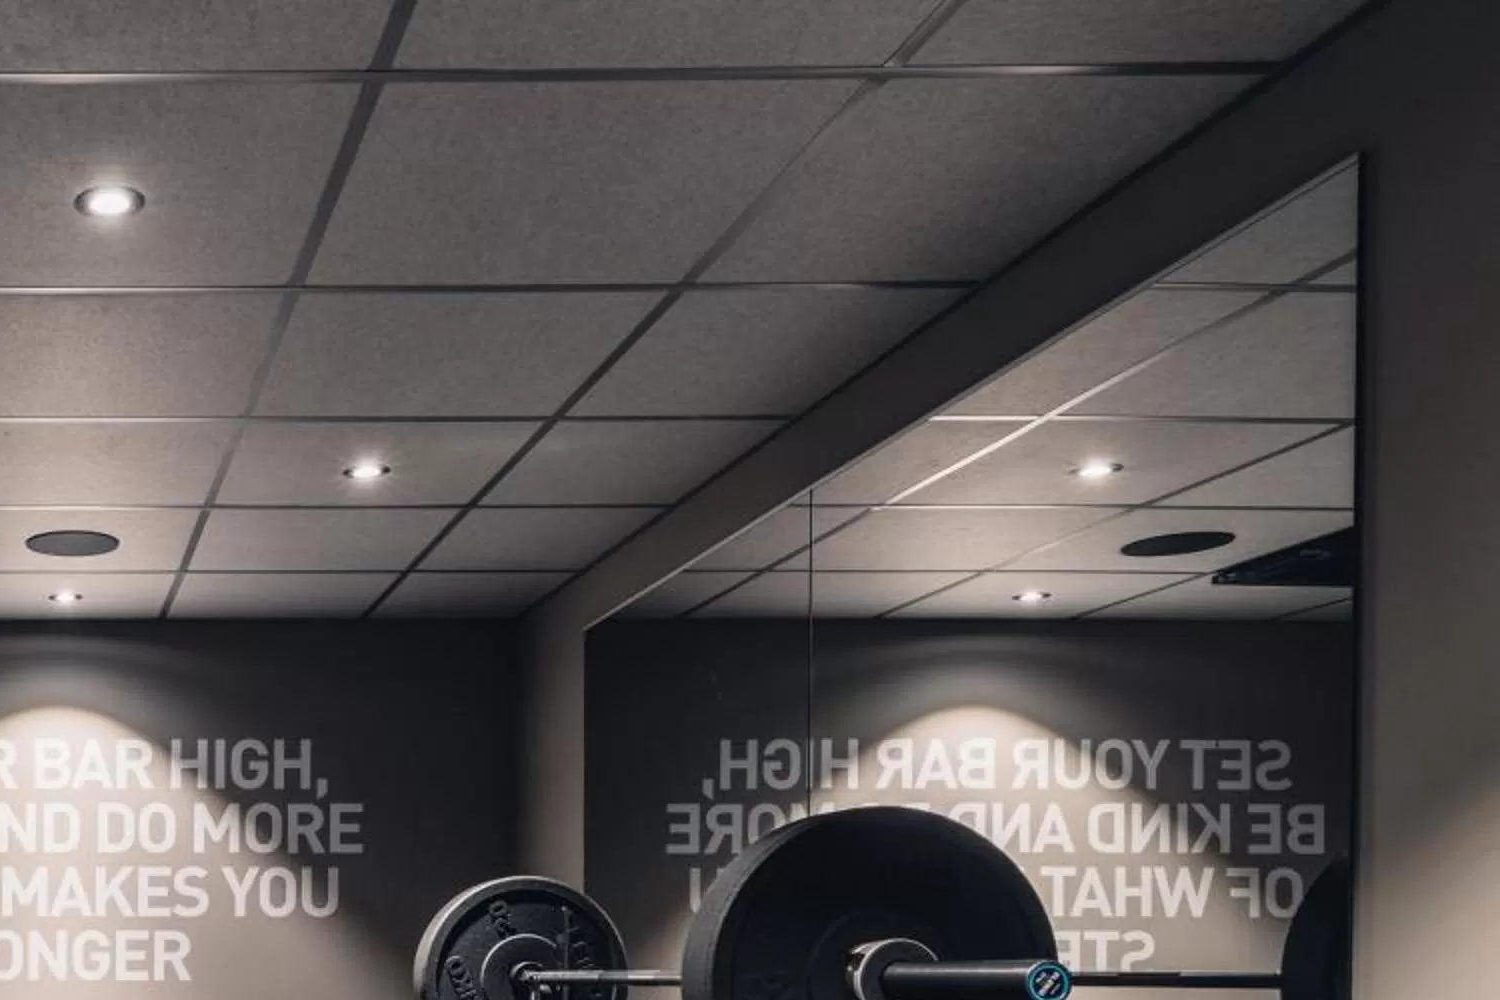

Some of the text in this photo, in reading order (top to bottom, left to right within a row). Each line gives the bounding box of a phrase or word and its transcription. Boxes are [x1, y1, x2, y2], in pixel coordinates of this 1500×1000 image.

[34, 738, 153, 790] BAR
[171, 738, 329, 798] HIGH,
[102, 802, 177, 853] DO
[193, 802, 364, 853] MORE
[2, 866, 209, 917] MAKES
[223, 866, 339, 917] YOU
